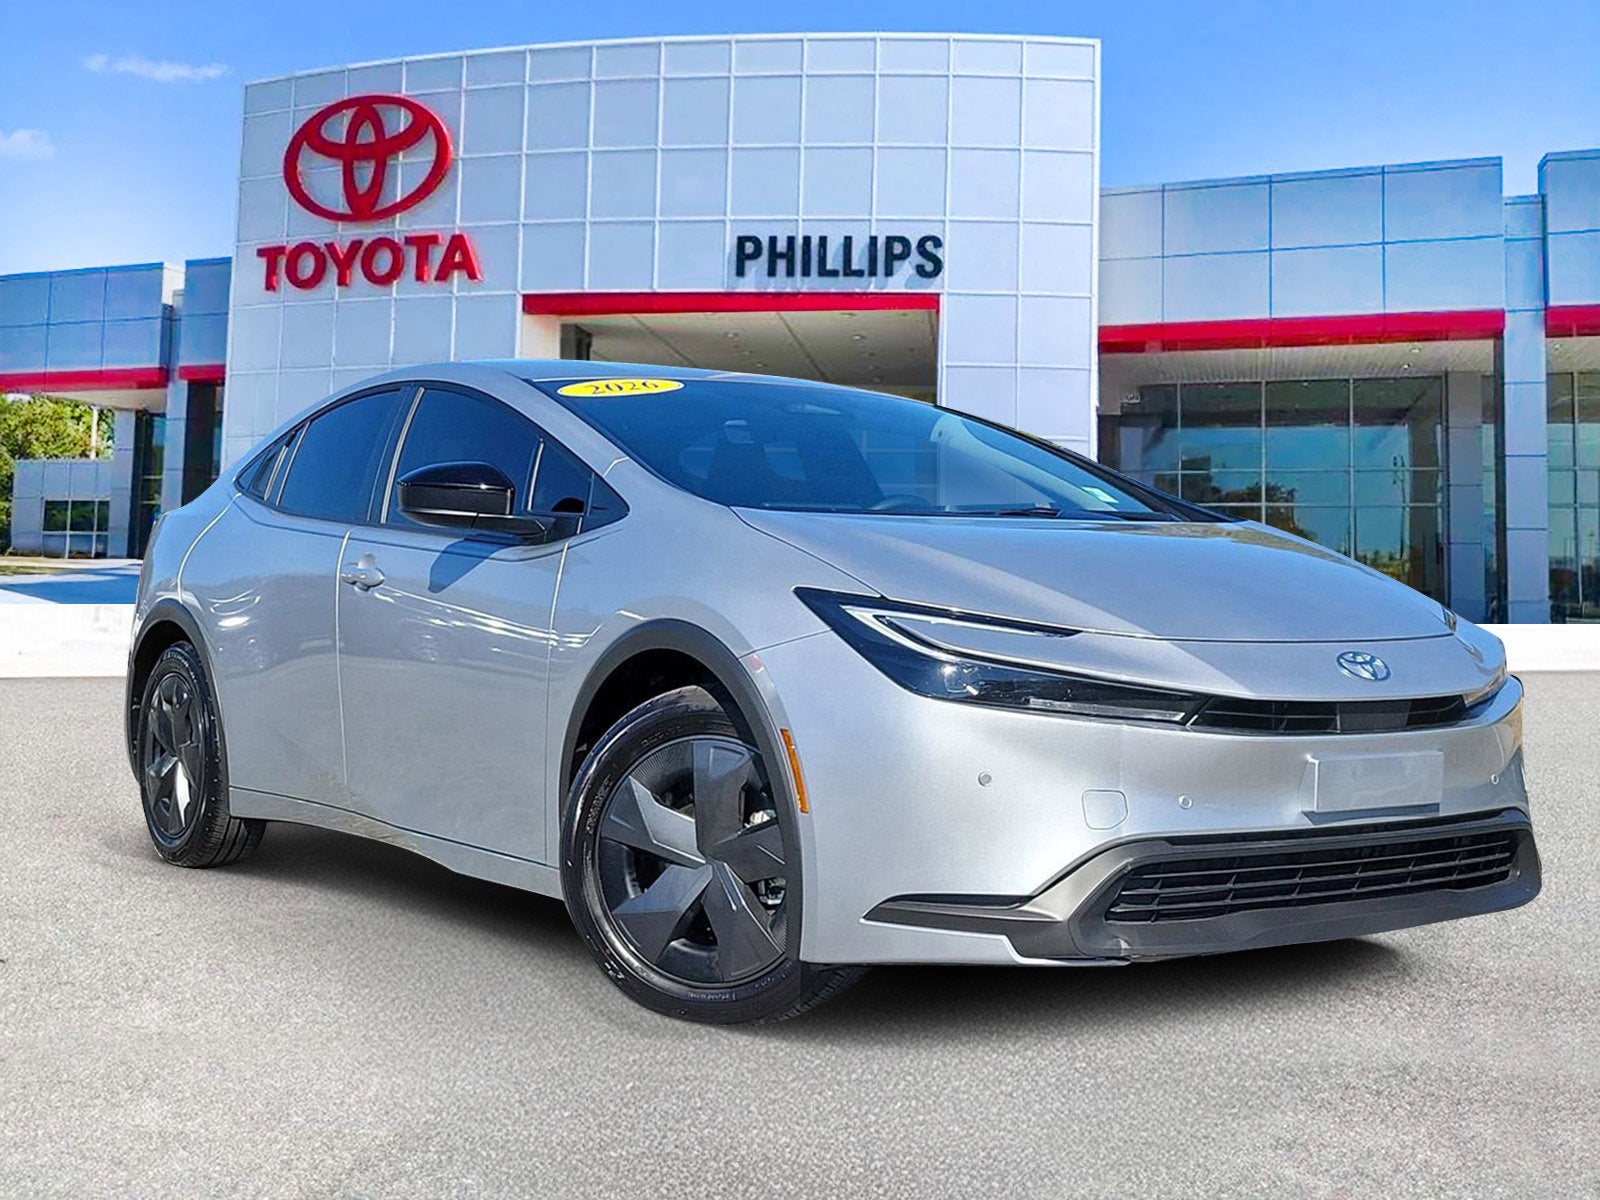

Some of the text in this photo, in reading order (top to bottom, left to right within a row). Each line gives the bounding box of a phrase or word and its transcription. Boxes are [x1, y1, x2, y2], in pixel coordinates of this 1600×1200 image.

[257, 232, 482, 292] TOYOTA
[735, 235, 944, 279] PHILLIPS
[584, 380, 660, 395] 2026
